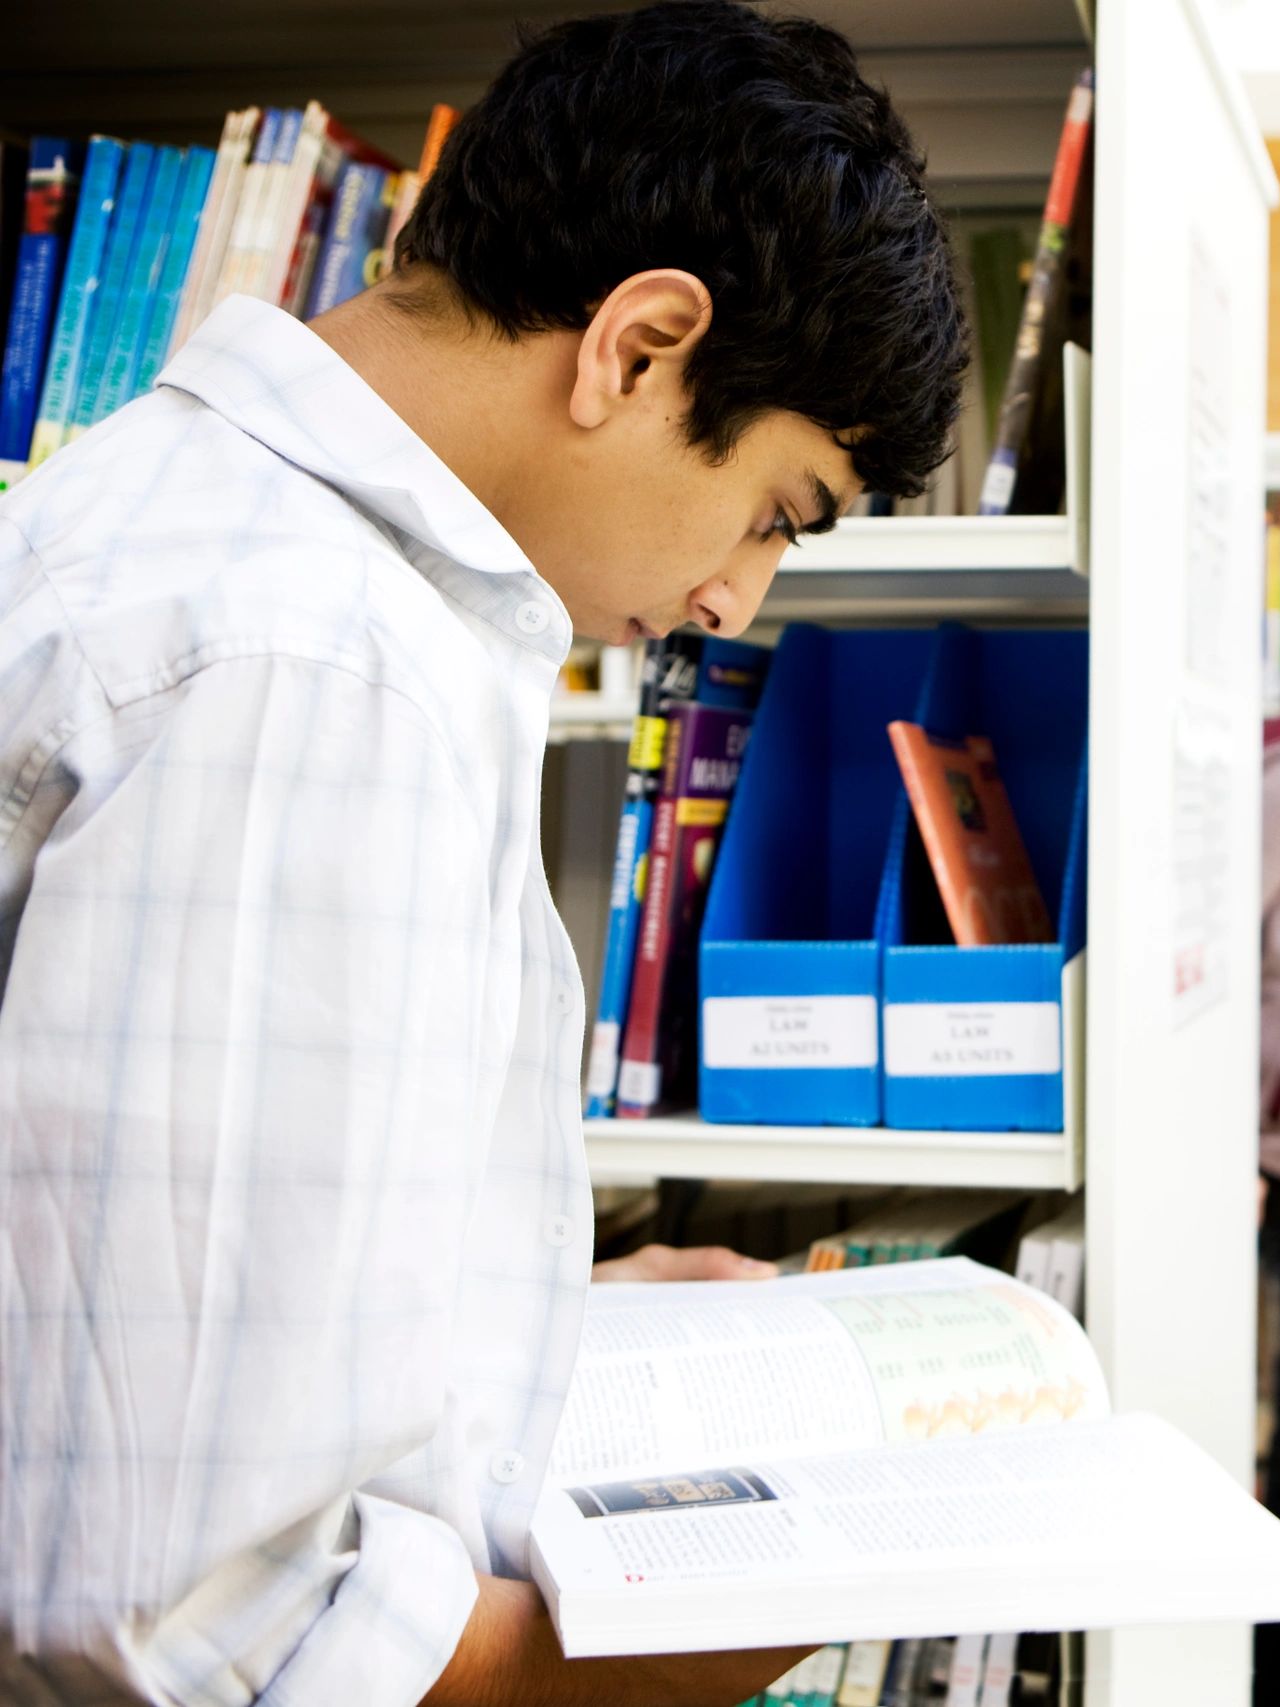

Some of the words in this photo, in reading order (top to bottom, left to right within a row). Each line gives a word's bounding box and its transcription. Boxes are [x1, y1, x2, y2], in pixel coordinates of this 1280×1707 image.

[642, 855, 668, 963] MANAGEMENT
[769, 1018, 808, 1032] LAW
[950, 1023, 990, 1038] LAW
[776, 1041, 830, 1055] UNITS
[957, 1049, 1014, 1063] UNITS
